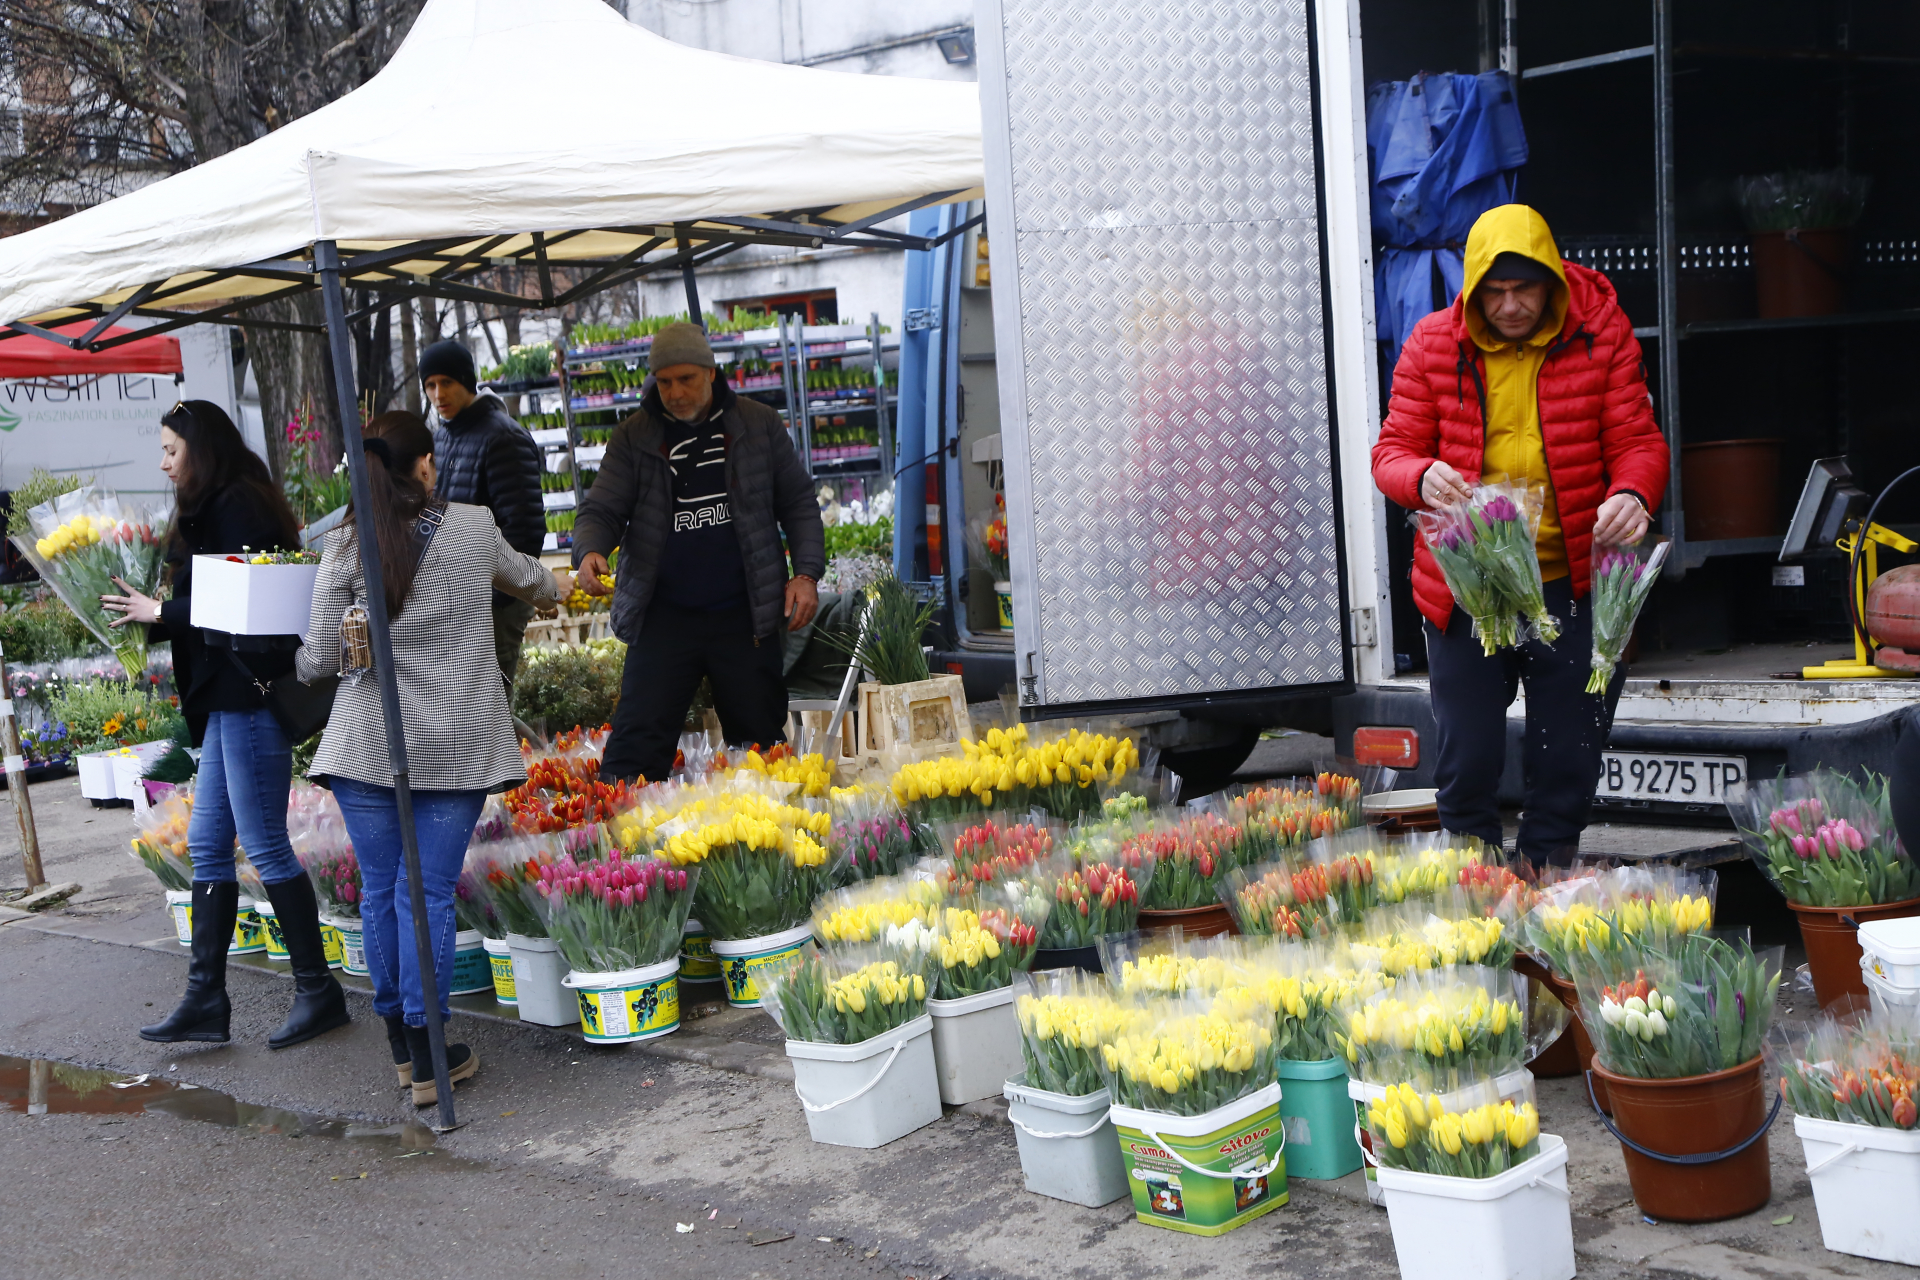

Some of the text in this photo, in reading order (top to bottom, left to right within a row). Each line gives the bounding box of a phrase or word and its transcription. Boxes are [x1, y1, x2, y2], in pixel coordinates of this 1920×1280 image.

[27, 408, 109, 423] FASZINATION
[1599, 757, 1741, 796] B 9275 TP
[1219, 1127, 1270, 1155] Sitovo
